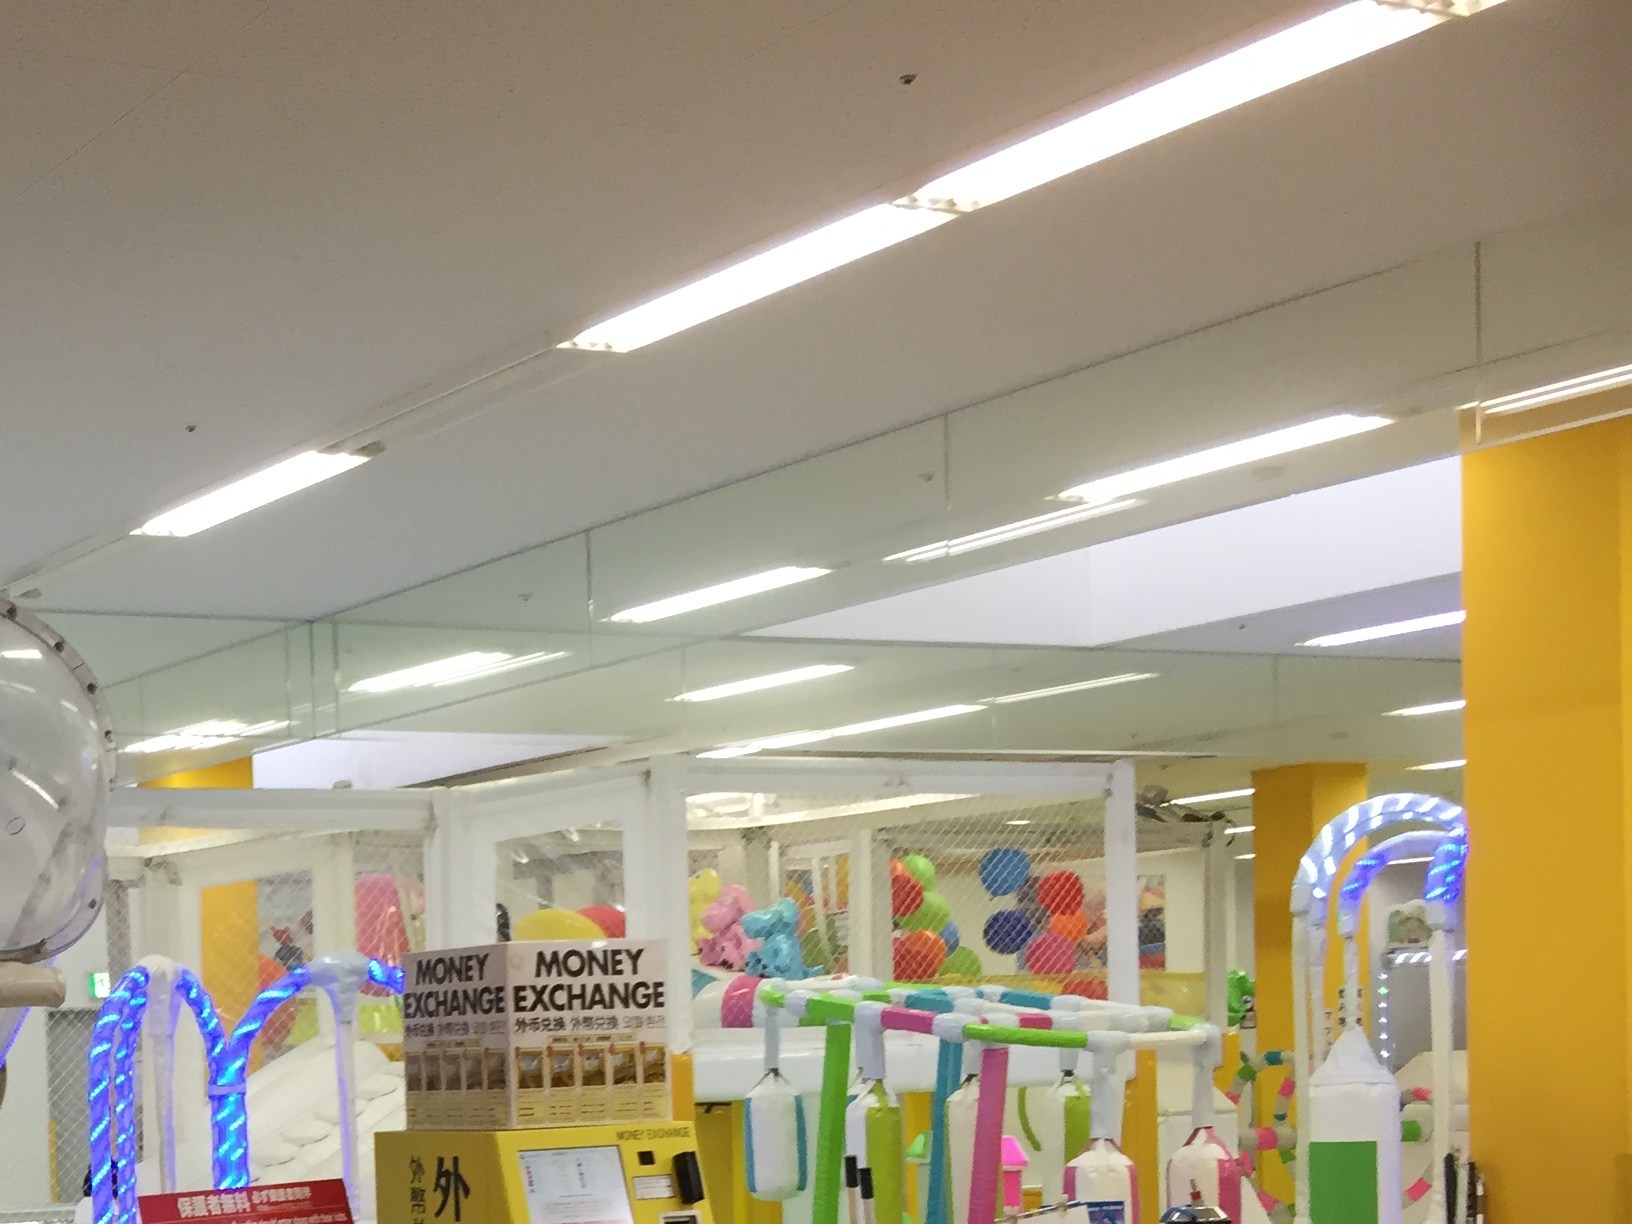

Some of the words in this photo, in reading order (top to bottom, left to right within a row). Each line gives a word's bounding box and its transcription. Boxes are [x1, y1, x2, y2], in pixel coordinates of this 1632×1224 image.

[415, 953, 489, 986] MONEY
[534, 948, 644, 978] MONEY
[404, 986, 506, 1019] EXCHANGE
[513, 981, 665, 1013] EXCHANGE
[616, 1129, 645, 1141] MONEY
[646, 1127, 690, 1140] EXCHANGE
